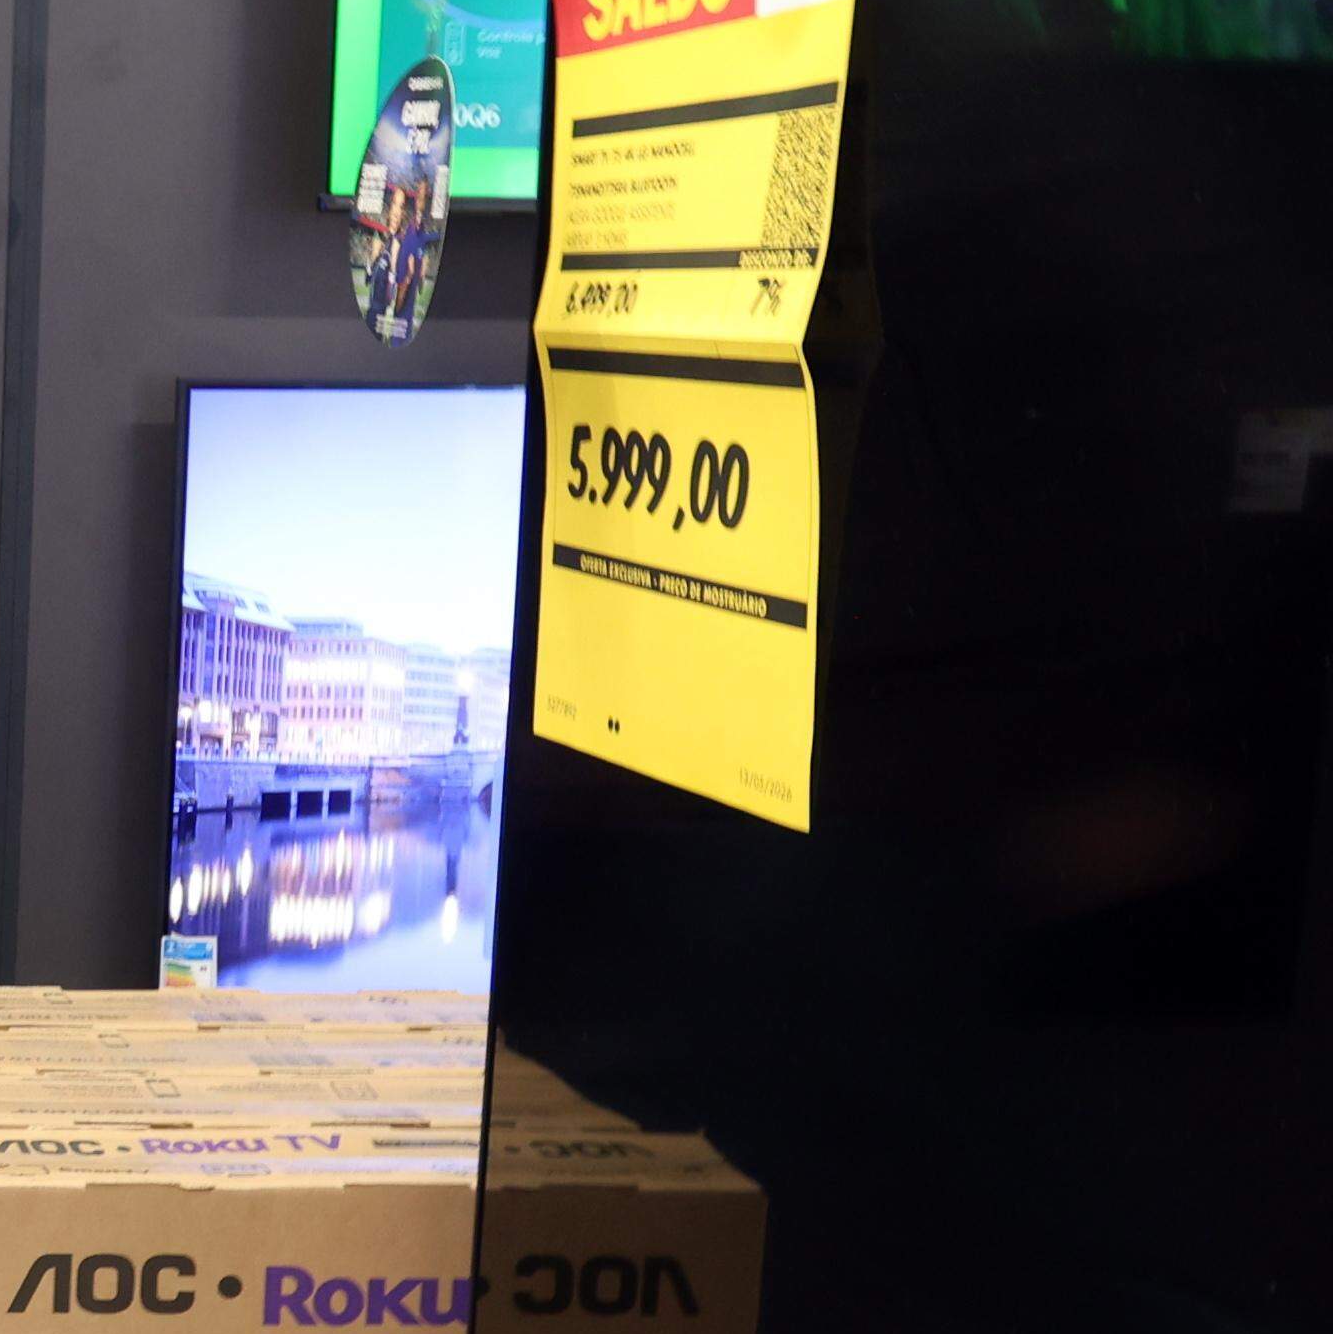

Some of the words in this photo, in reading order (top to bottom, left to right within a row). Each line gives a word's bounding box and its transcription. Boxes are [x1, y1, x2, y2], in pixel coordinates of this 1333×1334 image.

[568, 423, 750, 530] 5.999,00
[274, 1134, 341, 1151] TV
[7, 1253, 198, 1315] AOC
[262, 1265, 472, 1328] Roku
